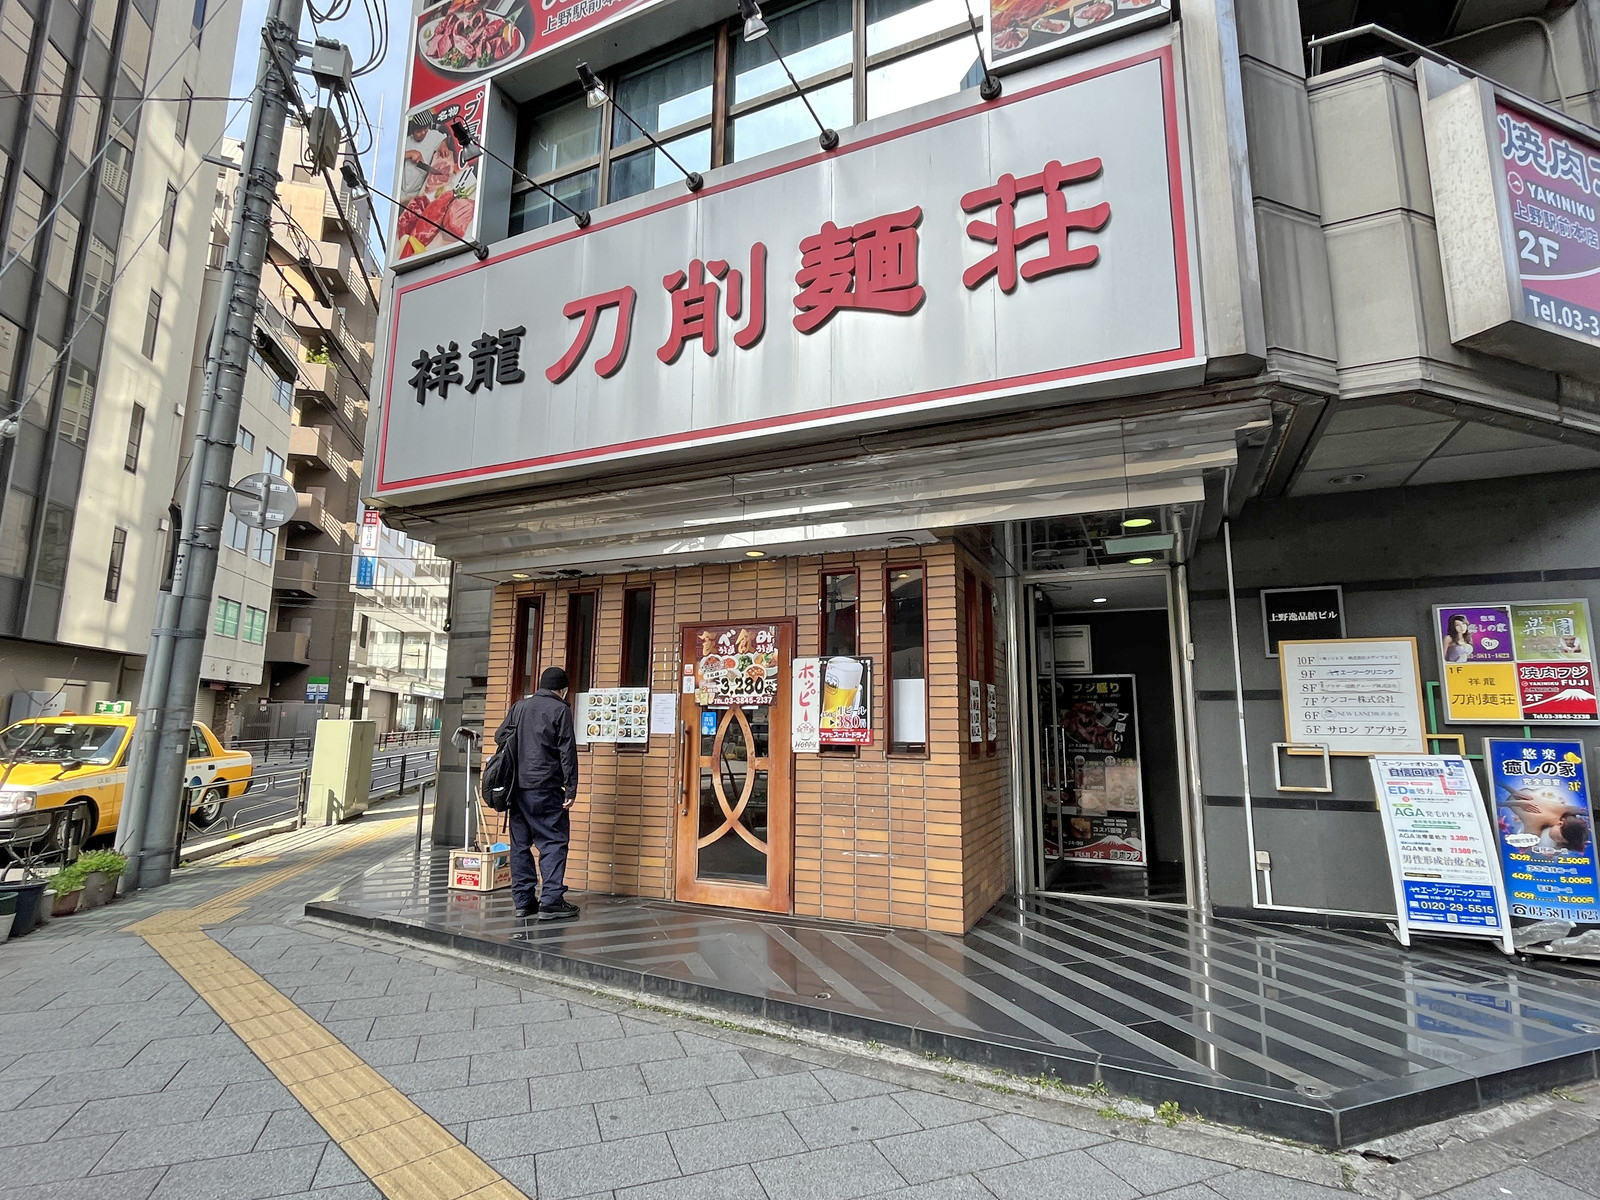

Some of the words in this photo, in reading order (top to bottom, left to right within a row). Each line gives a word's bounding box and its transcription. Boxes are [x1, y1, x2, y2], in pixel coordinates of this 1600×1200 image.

[542, 0, 626, 36] 上野駅前
[437, 106, 460, 122] 名物
[1527, 182, 1595, 221] YAKINIKU
[1514, 199, 1599, 250] 上野駅前本店
[1518, 230, 1559, 268] 2F
[408, 325, 527, 406] 祥龍
[545, 157, 1110, 385] 刀削麺荘
[1529, 294, 1600, 337] Tel.03-3
[1269, 611, 1338, 622] 上野逸品館ビル
[1523, 617, 1575, 637] 楽園
[1298, 656, 1315, 665] 10F
[1301, 670, 1316, 678] 9F
[1520, 666, 1588, 680] 焼肉フジ
[1302, 683, 1318, 692] 8F
[1468, 677, 1496, 686] 祥龍
[798, 661, 816, 722] ホッピー
[1525, 694, 1544, 702] 2F
[1303, 697, 1319, 706] 7F
[1321, 695, 1396, 704] ケンコー株式会社
[1304, 711, 1320, 719] 6F
[1306, 725, 1321, 733] 5F
[1328, 725, 1359, 734] サロン
[1522, 748, 1556, 760] 悠楽
[1503, 760, 1577, 777] 癒しの家
[1568, 781, 1582, 792] 3F
[1420, 886, 1475, 898] エーツークリニック
[1420, 901, 1494, 914] 0120-29-5515
[1529, 906, 1599, 920] 03-5811-1623
